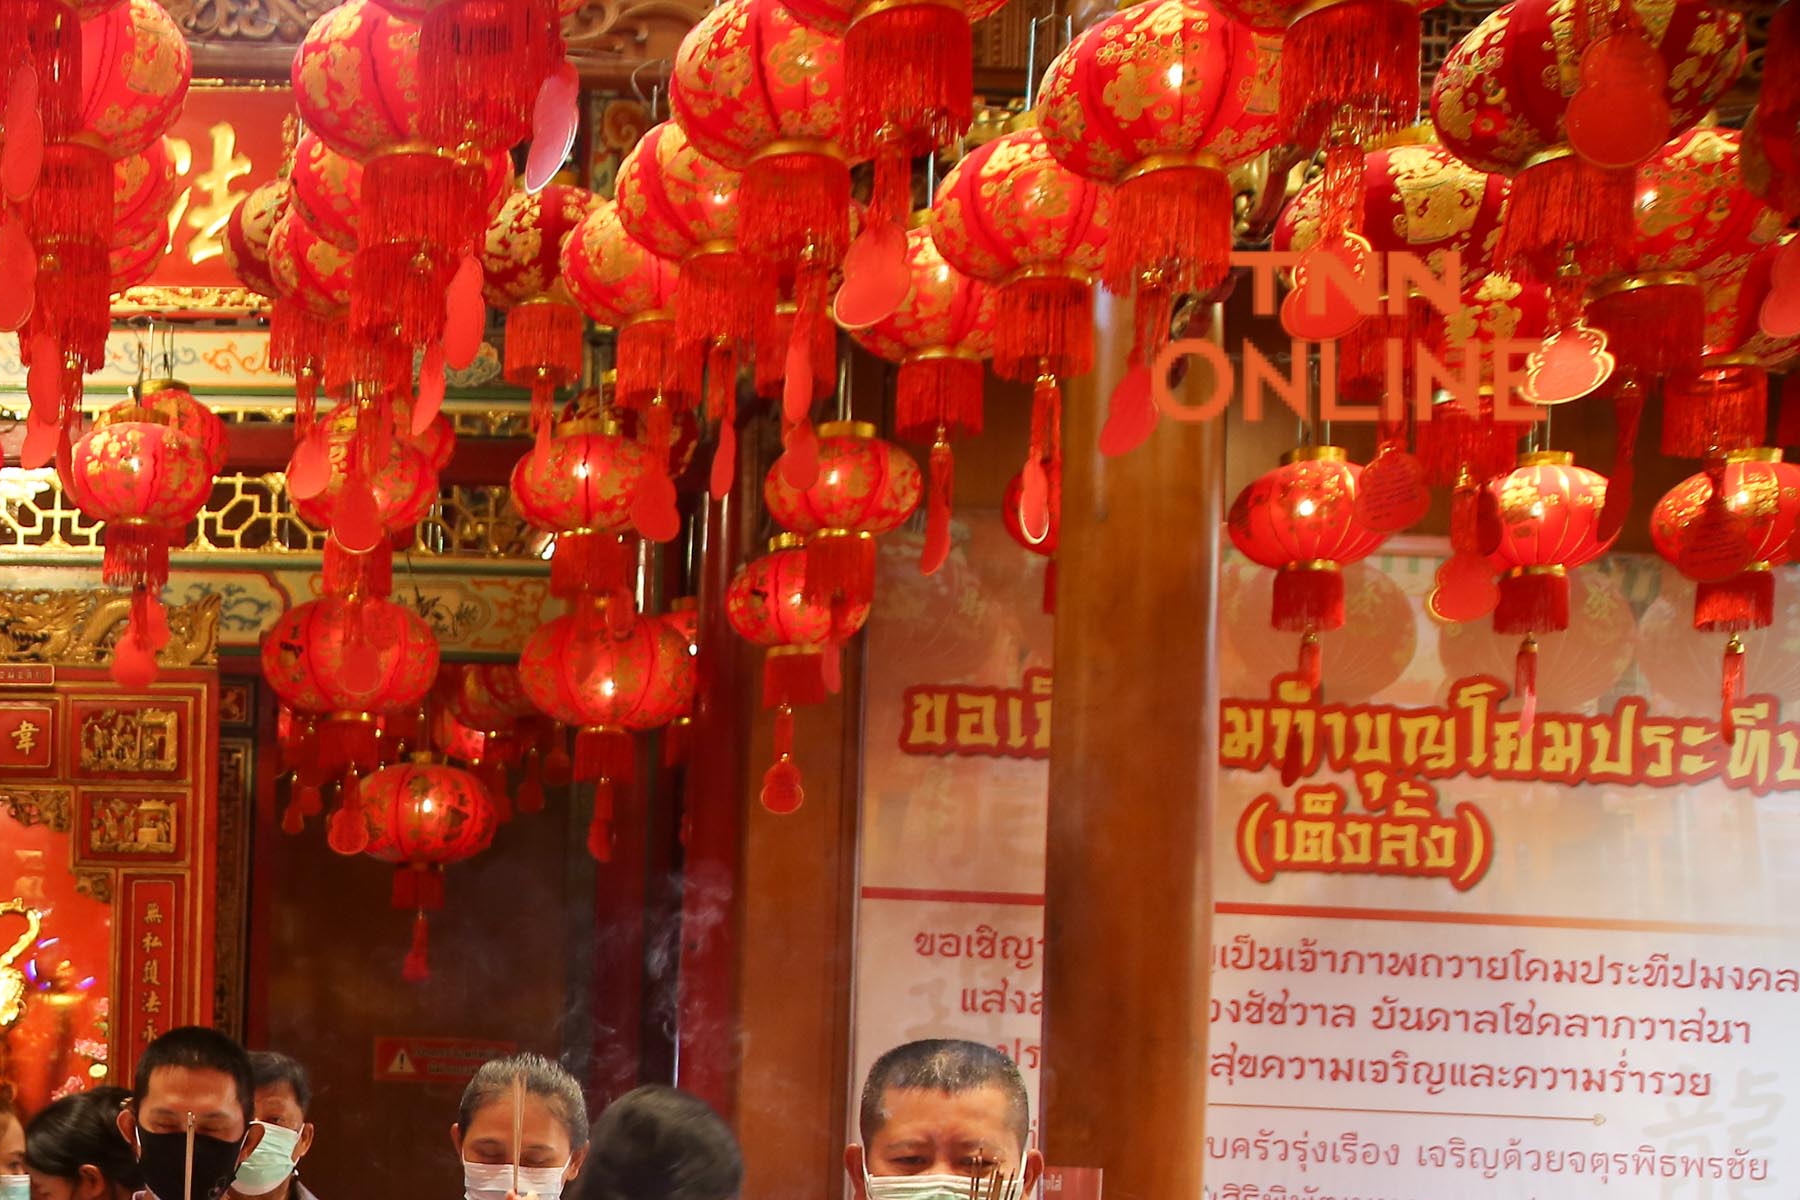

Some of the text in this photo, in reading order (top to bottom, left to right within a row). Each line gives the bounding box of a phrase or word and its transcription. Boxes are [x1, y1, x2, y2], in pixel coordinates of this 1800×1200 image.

[1241, 781, 1488, 886] (เต็งลั้ง)
[914, 924, 1044, 969] ขอเชิญ
[1210, 933, 1800, 993] เป็นเจ้าภาพถวายโคมประทีปมงคล
[1371, 996, 1751, 1044] บันดาลโชคลาภวาสนา
[1210, 1042, 1712, 1097] สุขความเจริญและความร่ำรวย
[1206, 1128, 1768, 1184] บครัวรุ่งเรือง เจริญด้วยจตุรพิธพรชัย
